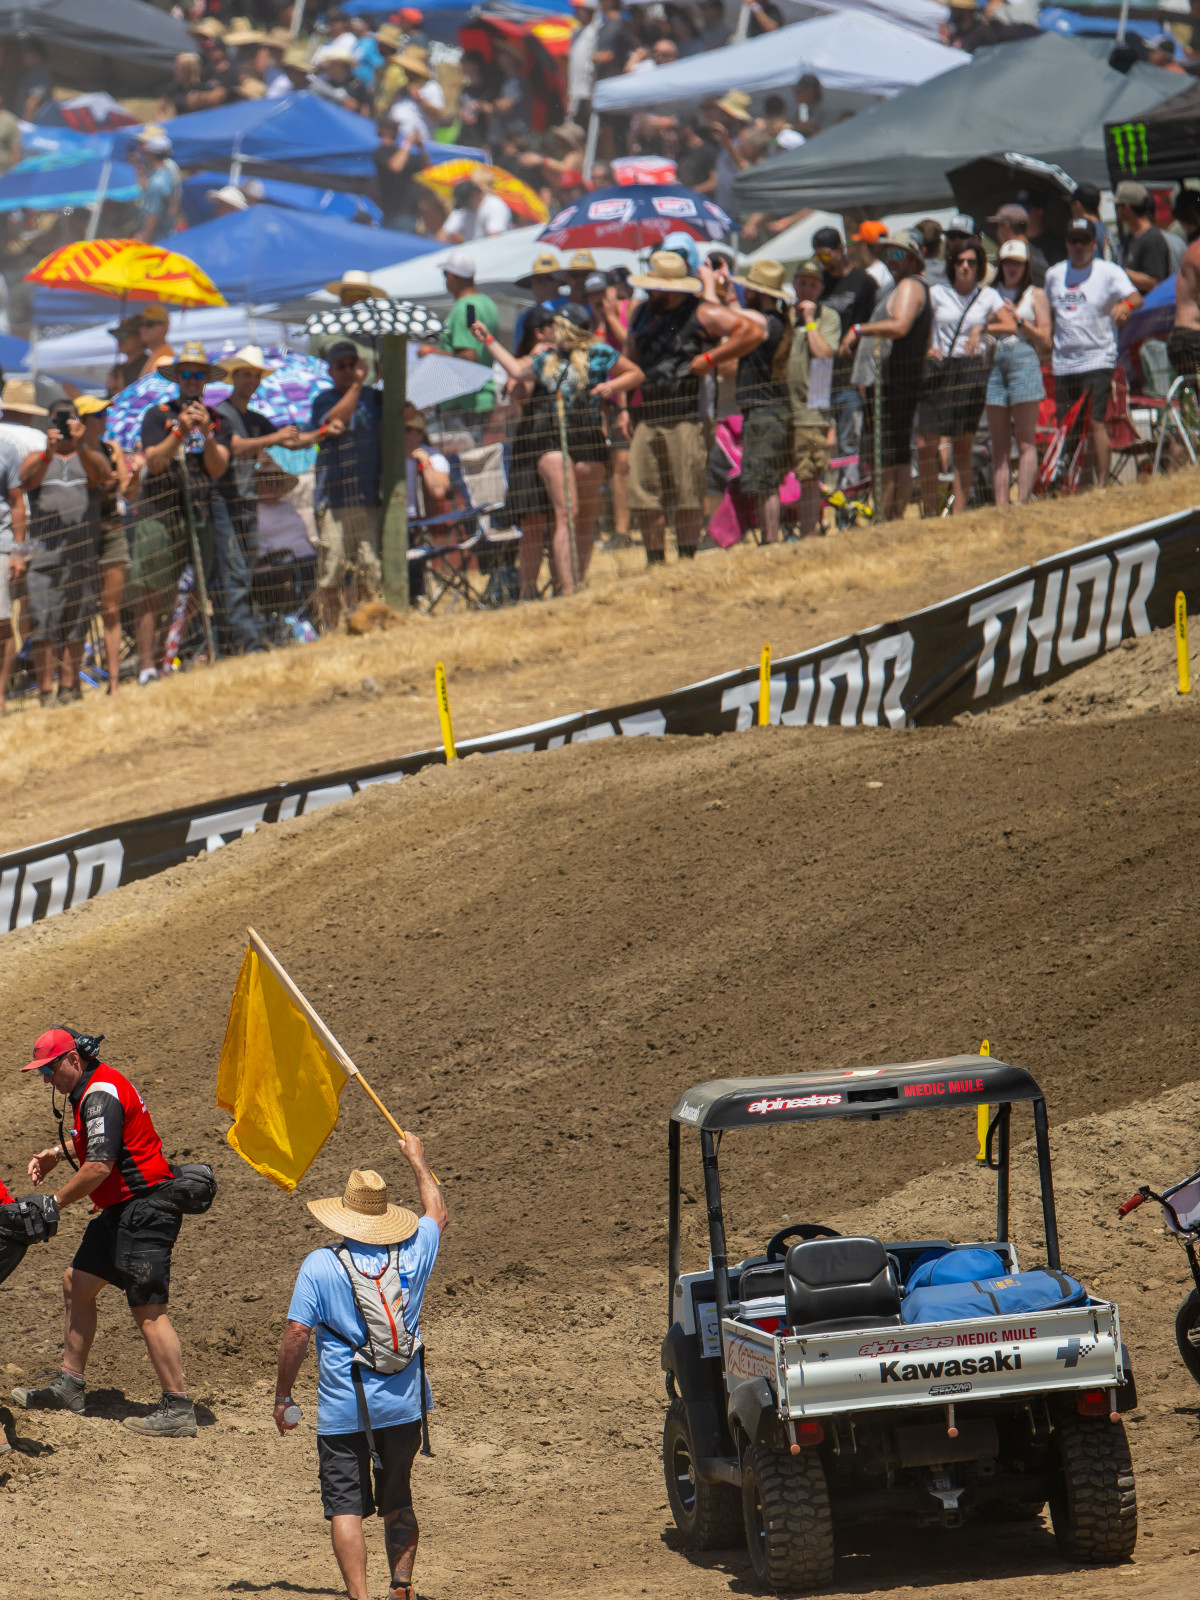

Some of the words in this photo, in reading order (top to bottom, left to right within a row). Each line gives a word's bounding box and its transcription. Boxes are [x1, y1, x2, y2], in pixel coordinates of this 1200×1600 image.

[968, 539, 1160, 698] THOR
[904, 1082, 945, 1097] MEDIC
[949, 1079, 984, 1093] MULE
[747, 1093, 843, 1115] alpinestars
[956, 1331, 998, 1346] MEDIC
[1002, 1327, 1038, 1342] MULE
[879, 1345, 1022, 1384] Kawasaki
